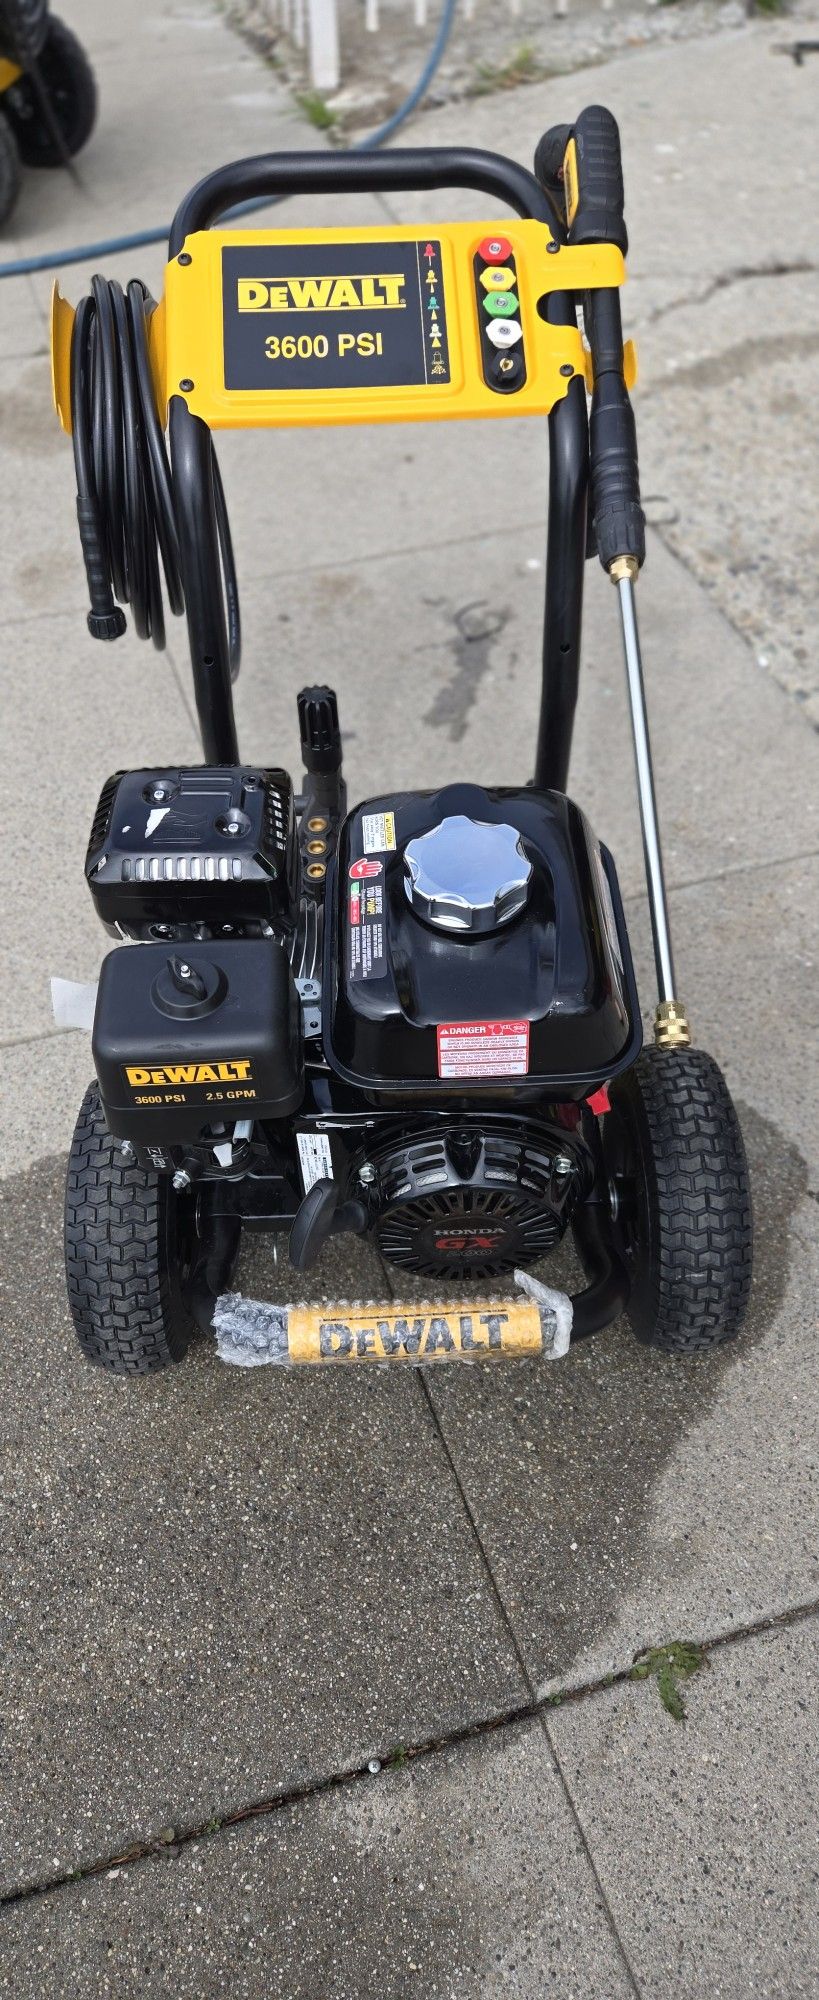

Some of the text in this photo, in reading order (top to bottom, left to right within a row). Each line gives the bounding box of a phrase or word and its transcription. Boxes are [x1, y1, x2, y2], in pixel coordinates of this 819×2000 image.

[264, 332, 383, 359] 3600 PSI
[449, 1026, 486, 1035] DANGER
[134, 1089, 256, 1104] 3600 PSI 2.5 GPM
[433, 1227, 507, 1236] HONDA
[435, 1236, 502, 1249] GX
